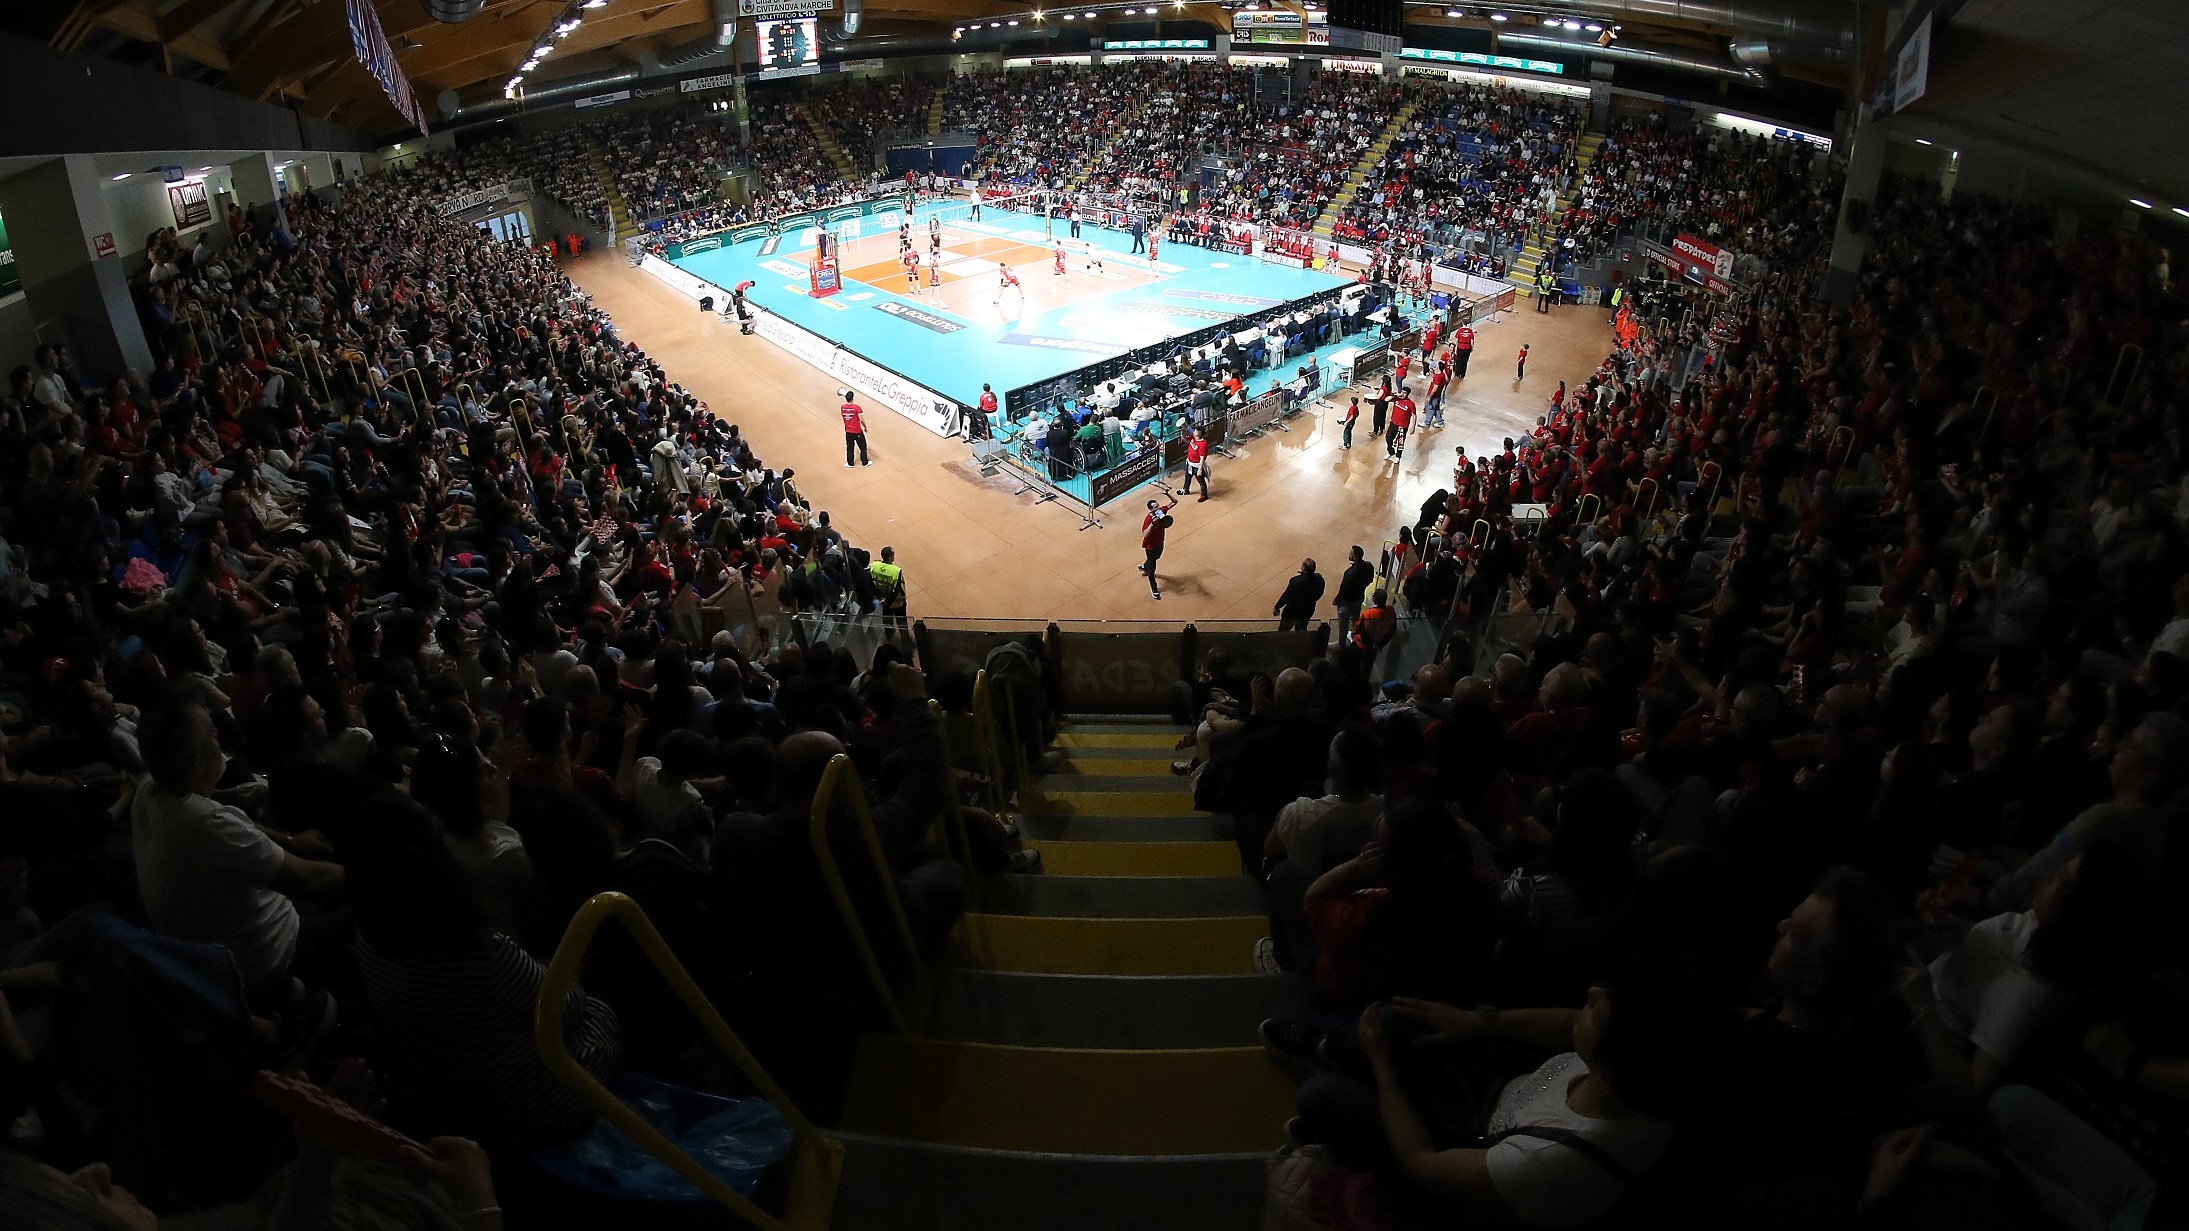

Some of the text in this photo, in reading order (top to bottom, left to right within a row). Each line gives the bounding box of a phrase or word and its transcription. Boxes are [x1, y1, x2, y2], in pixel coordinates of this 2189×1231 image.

[756, 1, 831, 13] CIVITANOVA MARCHE
[1254, 14, 1274, 23] comet
[1414, 67, 1448, 77] MALAGRIDA
[696, 74, 731, 84] FARMACIE
[697, 81, 731, 90] ANGELINI
[1672, 238, 1717, 265] PREDATORS
[1650, 250, 1680, 271] OFFICIAL STORE
[1709, 279, 1729, 296] OFFICIAL
[1110, 453, 1158, 485] MASSACCESI
